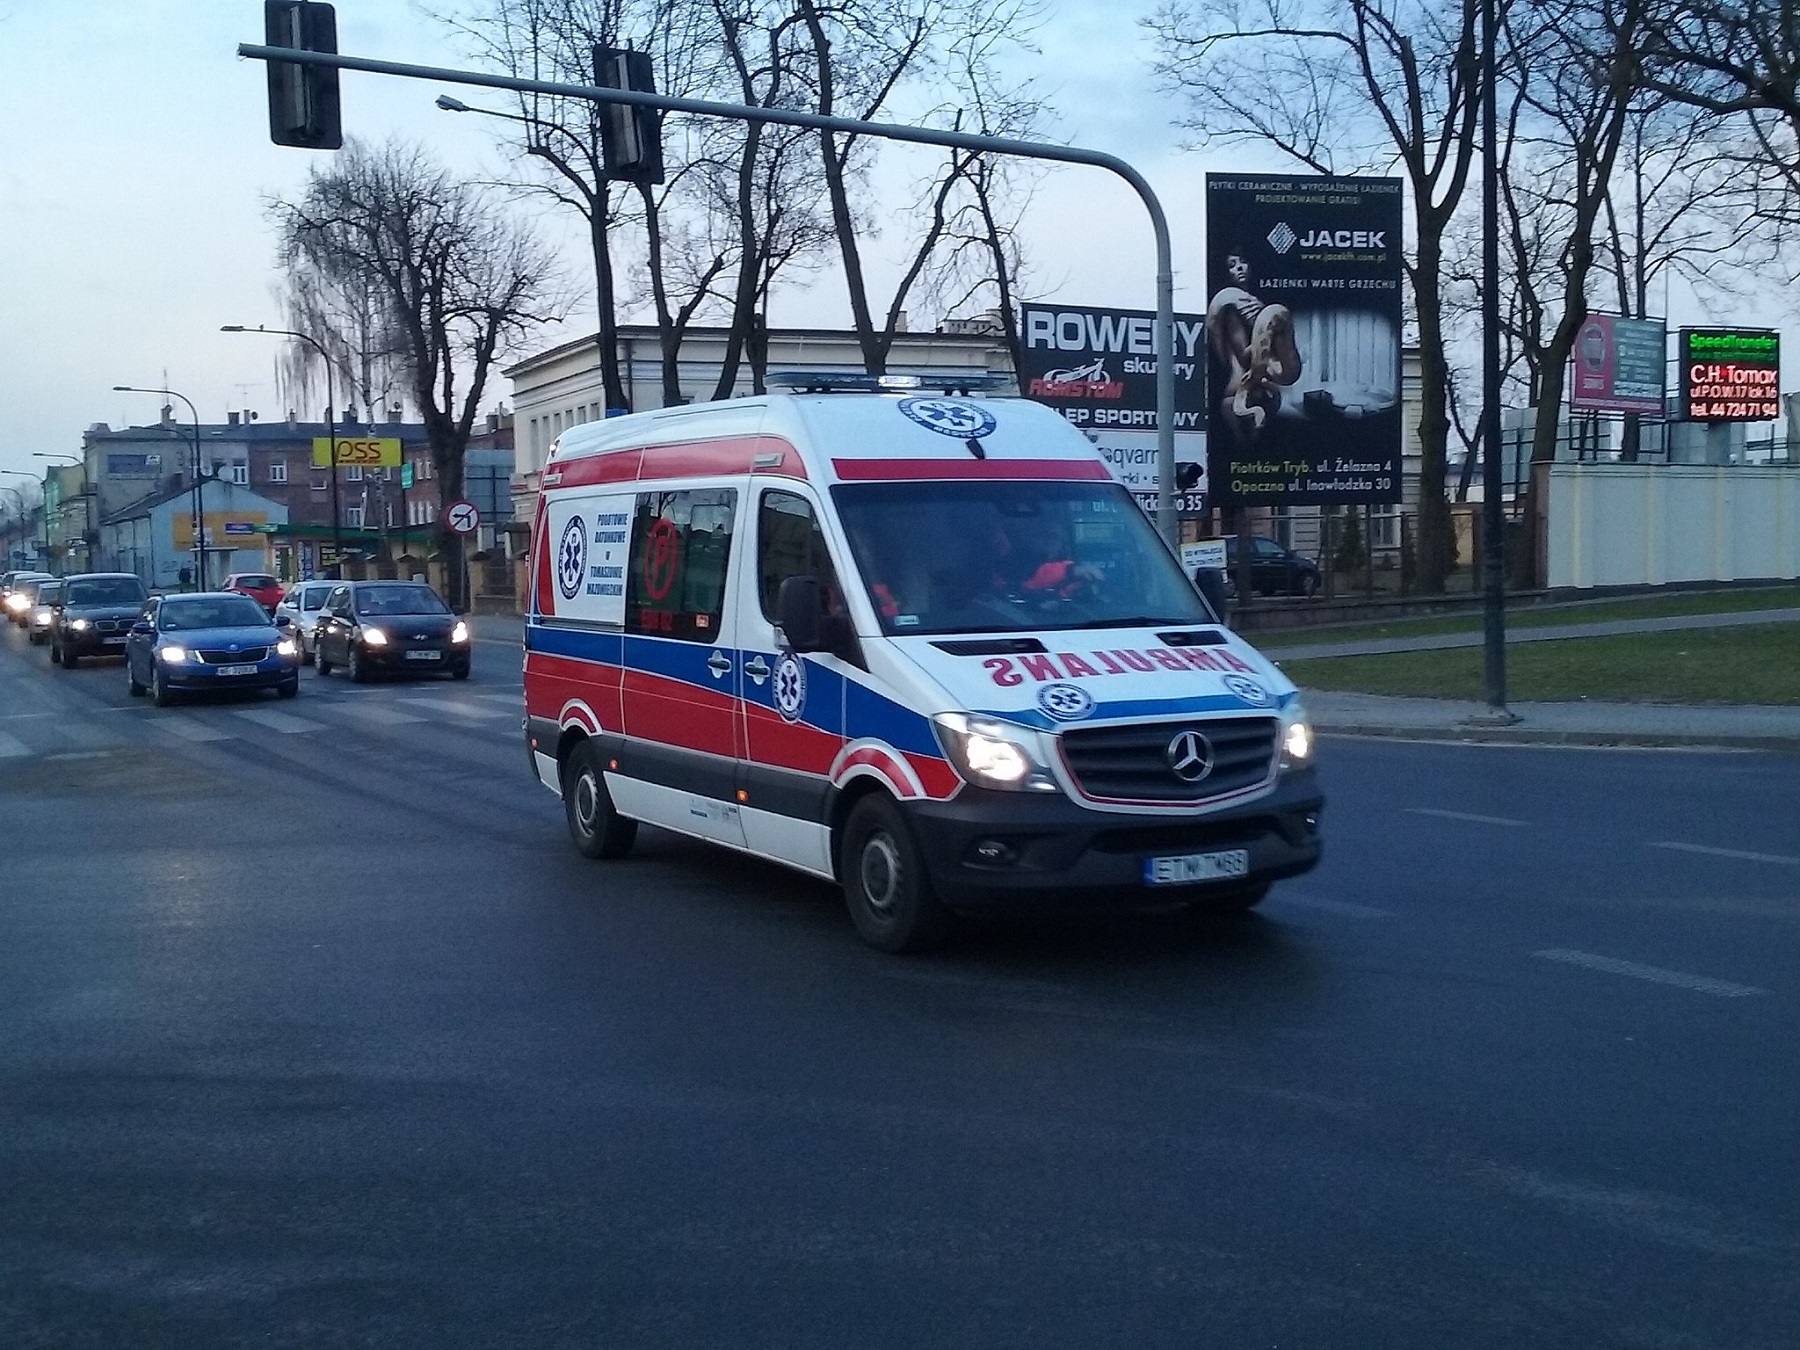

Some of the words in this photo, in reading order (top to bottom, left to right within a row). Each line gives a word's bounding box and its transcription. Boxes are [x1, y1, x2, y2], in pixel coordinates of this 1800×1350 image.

[1300, 230, 1386, 248] JACEK
[1259, 279, 1307, 288] ŁAZIENKI
[1311, 279, 1345, 289] WARTE
[1349, 279, 1396, 289] GRZECHU
[1123, 357, 1195, 380] skury
[1094, 410, 1199, 427] SPORTWY
[1230, 461, 1279, 474] Piotrków
[1283, 460, 1313, 476] Tryb.
[1317, 460, 1331, 472] ul.
[1335, 457, 1381, 472] Żelazna
[1384, 460, 1392, 471] 4
[1231, 479, 1285, 495] Opoczno
[1288, 479, 1302, 492] ul.
[1306, 478, 1372, 491] Inowłodzka
[1375, 478, 1392, 490] 30
[1186, 495, 1202, 511] 35
